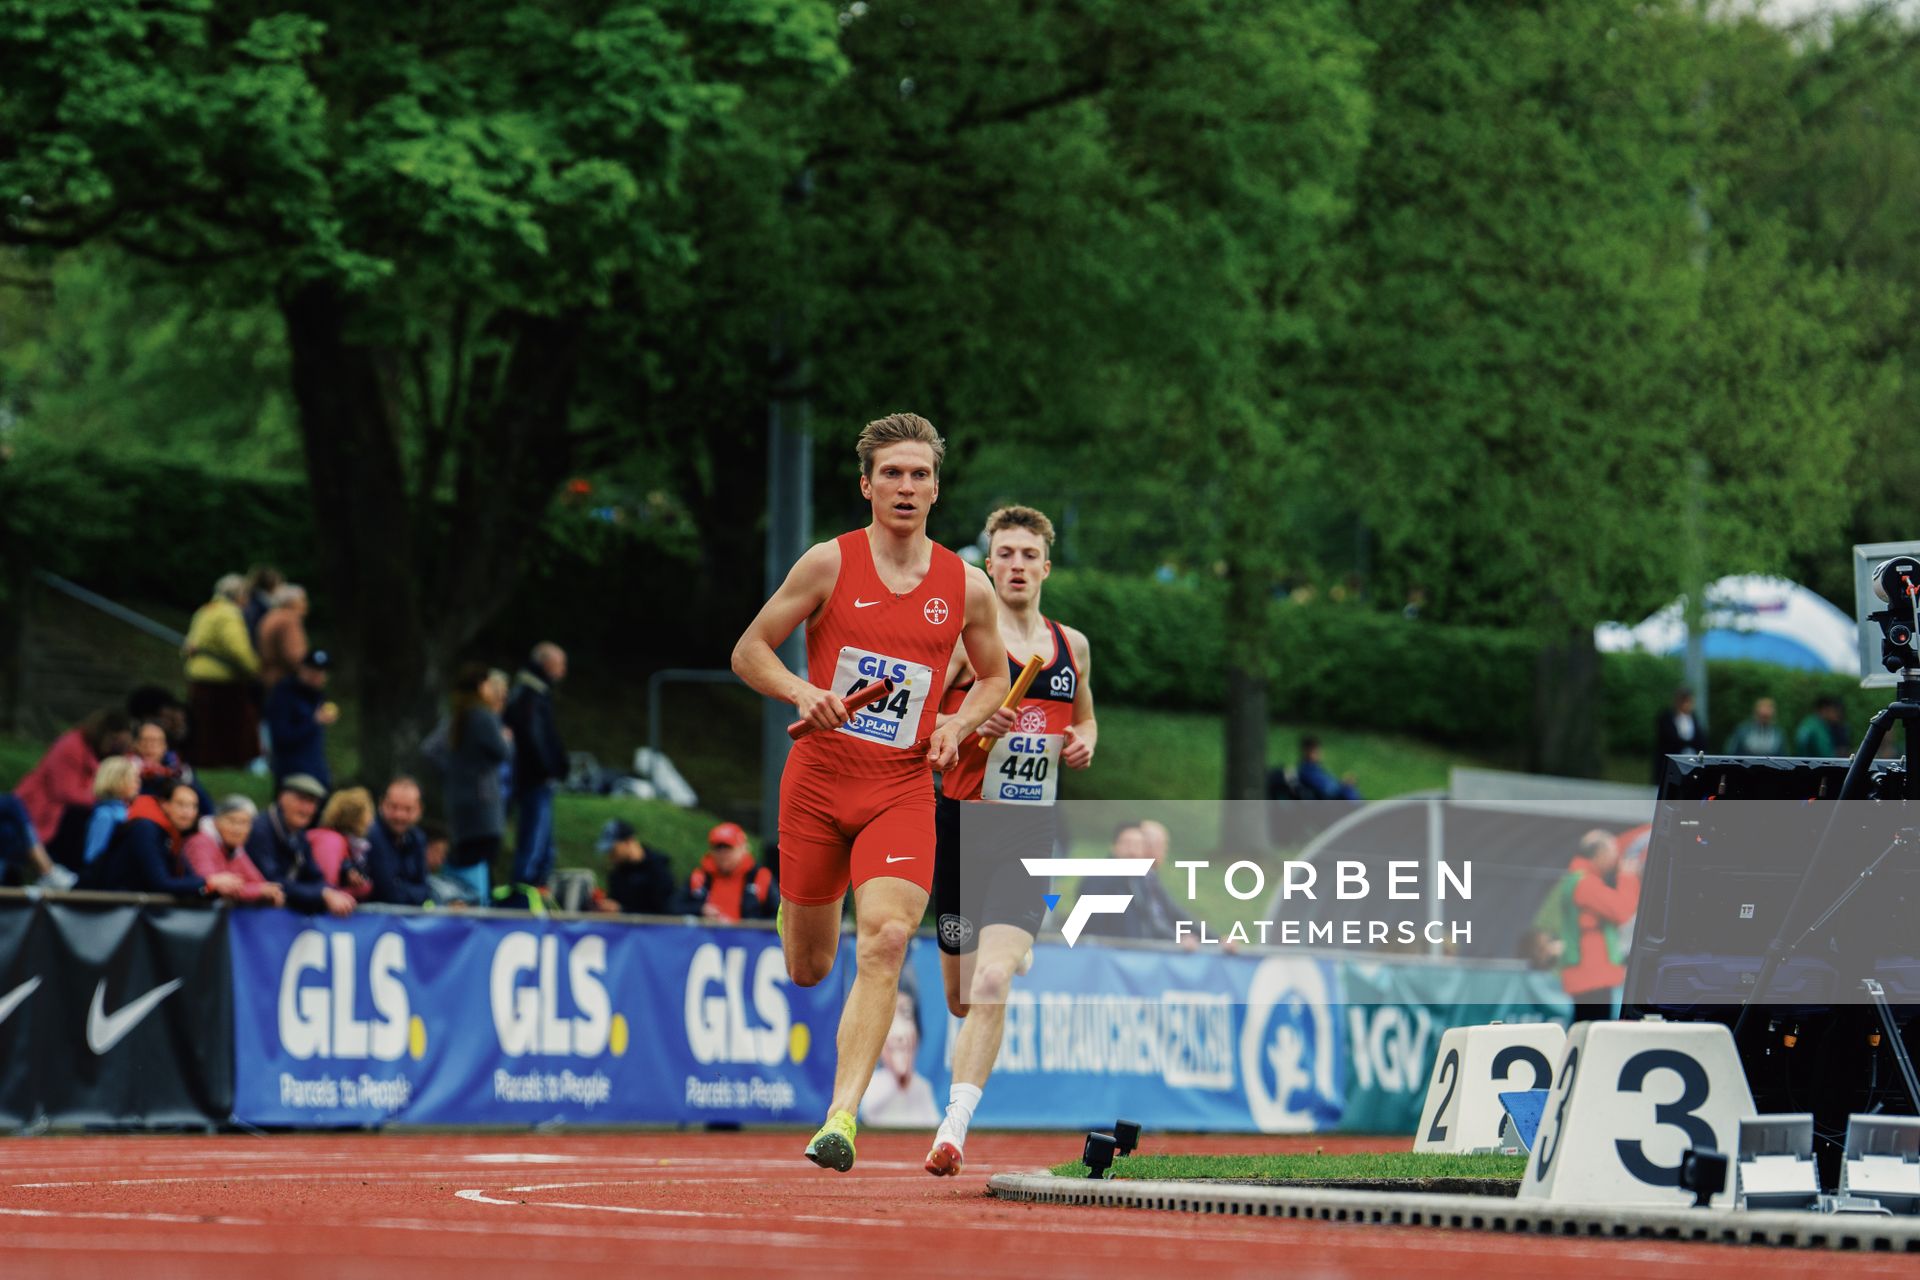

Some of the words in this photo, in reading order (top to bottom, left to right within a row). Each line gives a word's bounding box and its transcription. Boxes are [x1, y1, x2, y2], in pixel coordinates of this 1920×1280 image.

[1050, 675, 1070, 691] OS
[866, 719, 896, 734] PLAN
[999, 755, 1049, 782] 440
[1019, 786, 1041, 796] PLAN
[1427, 1048, 1459, 1142] 2
[1537, 1046, 1578, 1183] 3
[1614, 1048, 1718, 1187] 3
